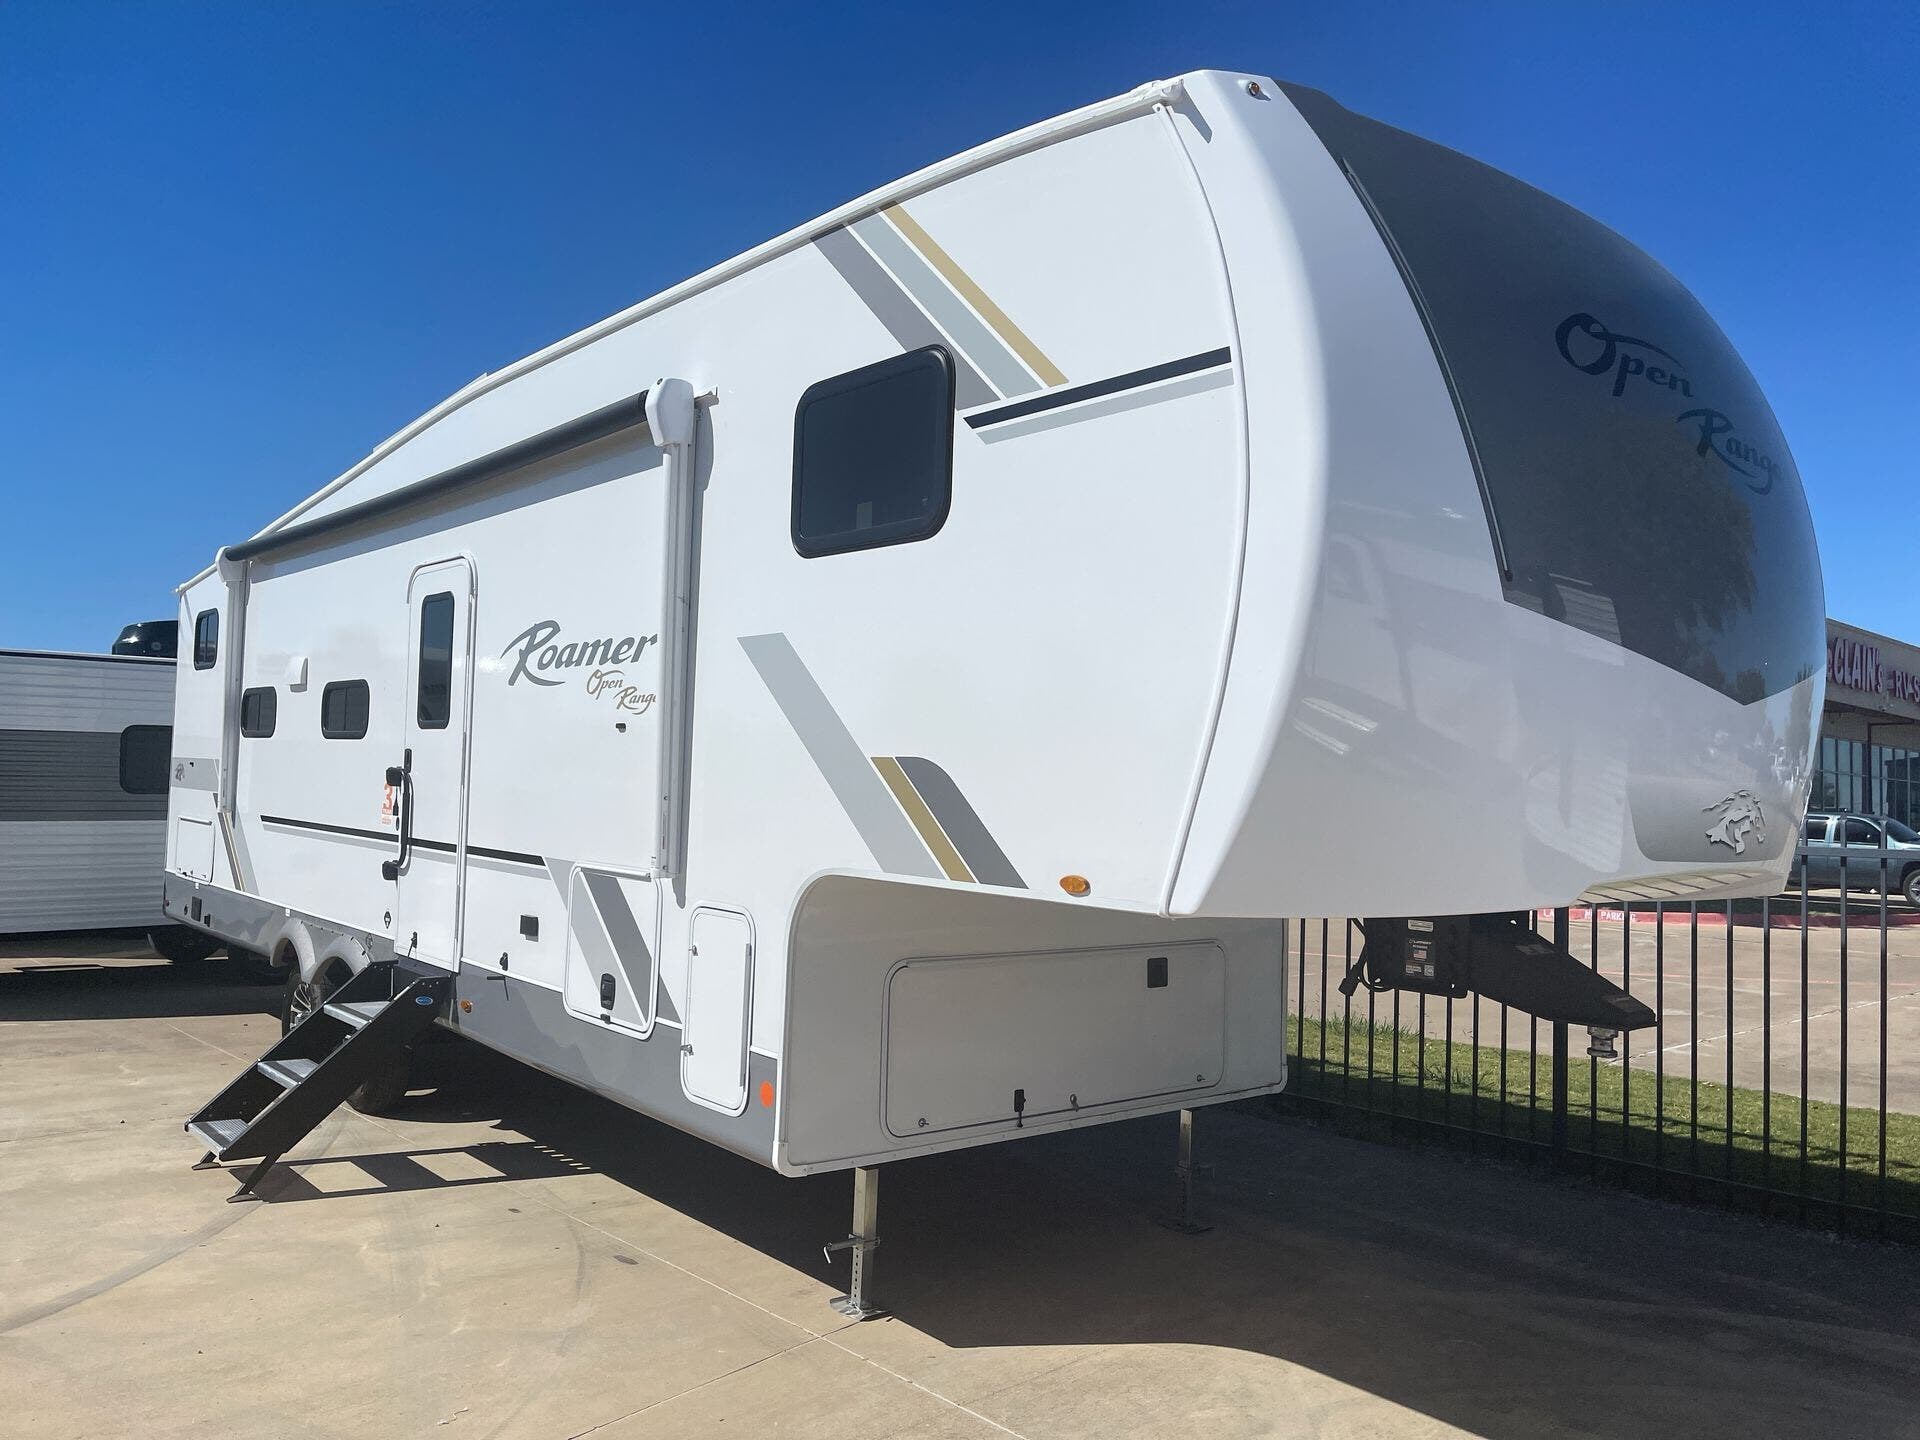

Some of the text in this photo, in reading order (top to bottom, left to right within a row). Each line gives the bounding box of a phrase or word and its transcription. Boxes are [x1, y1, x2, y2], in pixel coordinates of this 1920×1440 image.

[1555, 312, 1695, 397] Open
[500, 619, 658, 687] Roamer
[586, 668, 625, 701] Open
[1600, 912, 1636, 921] PARKIG
